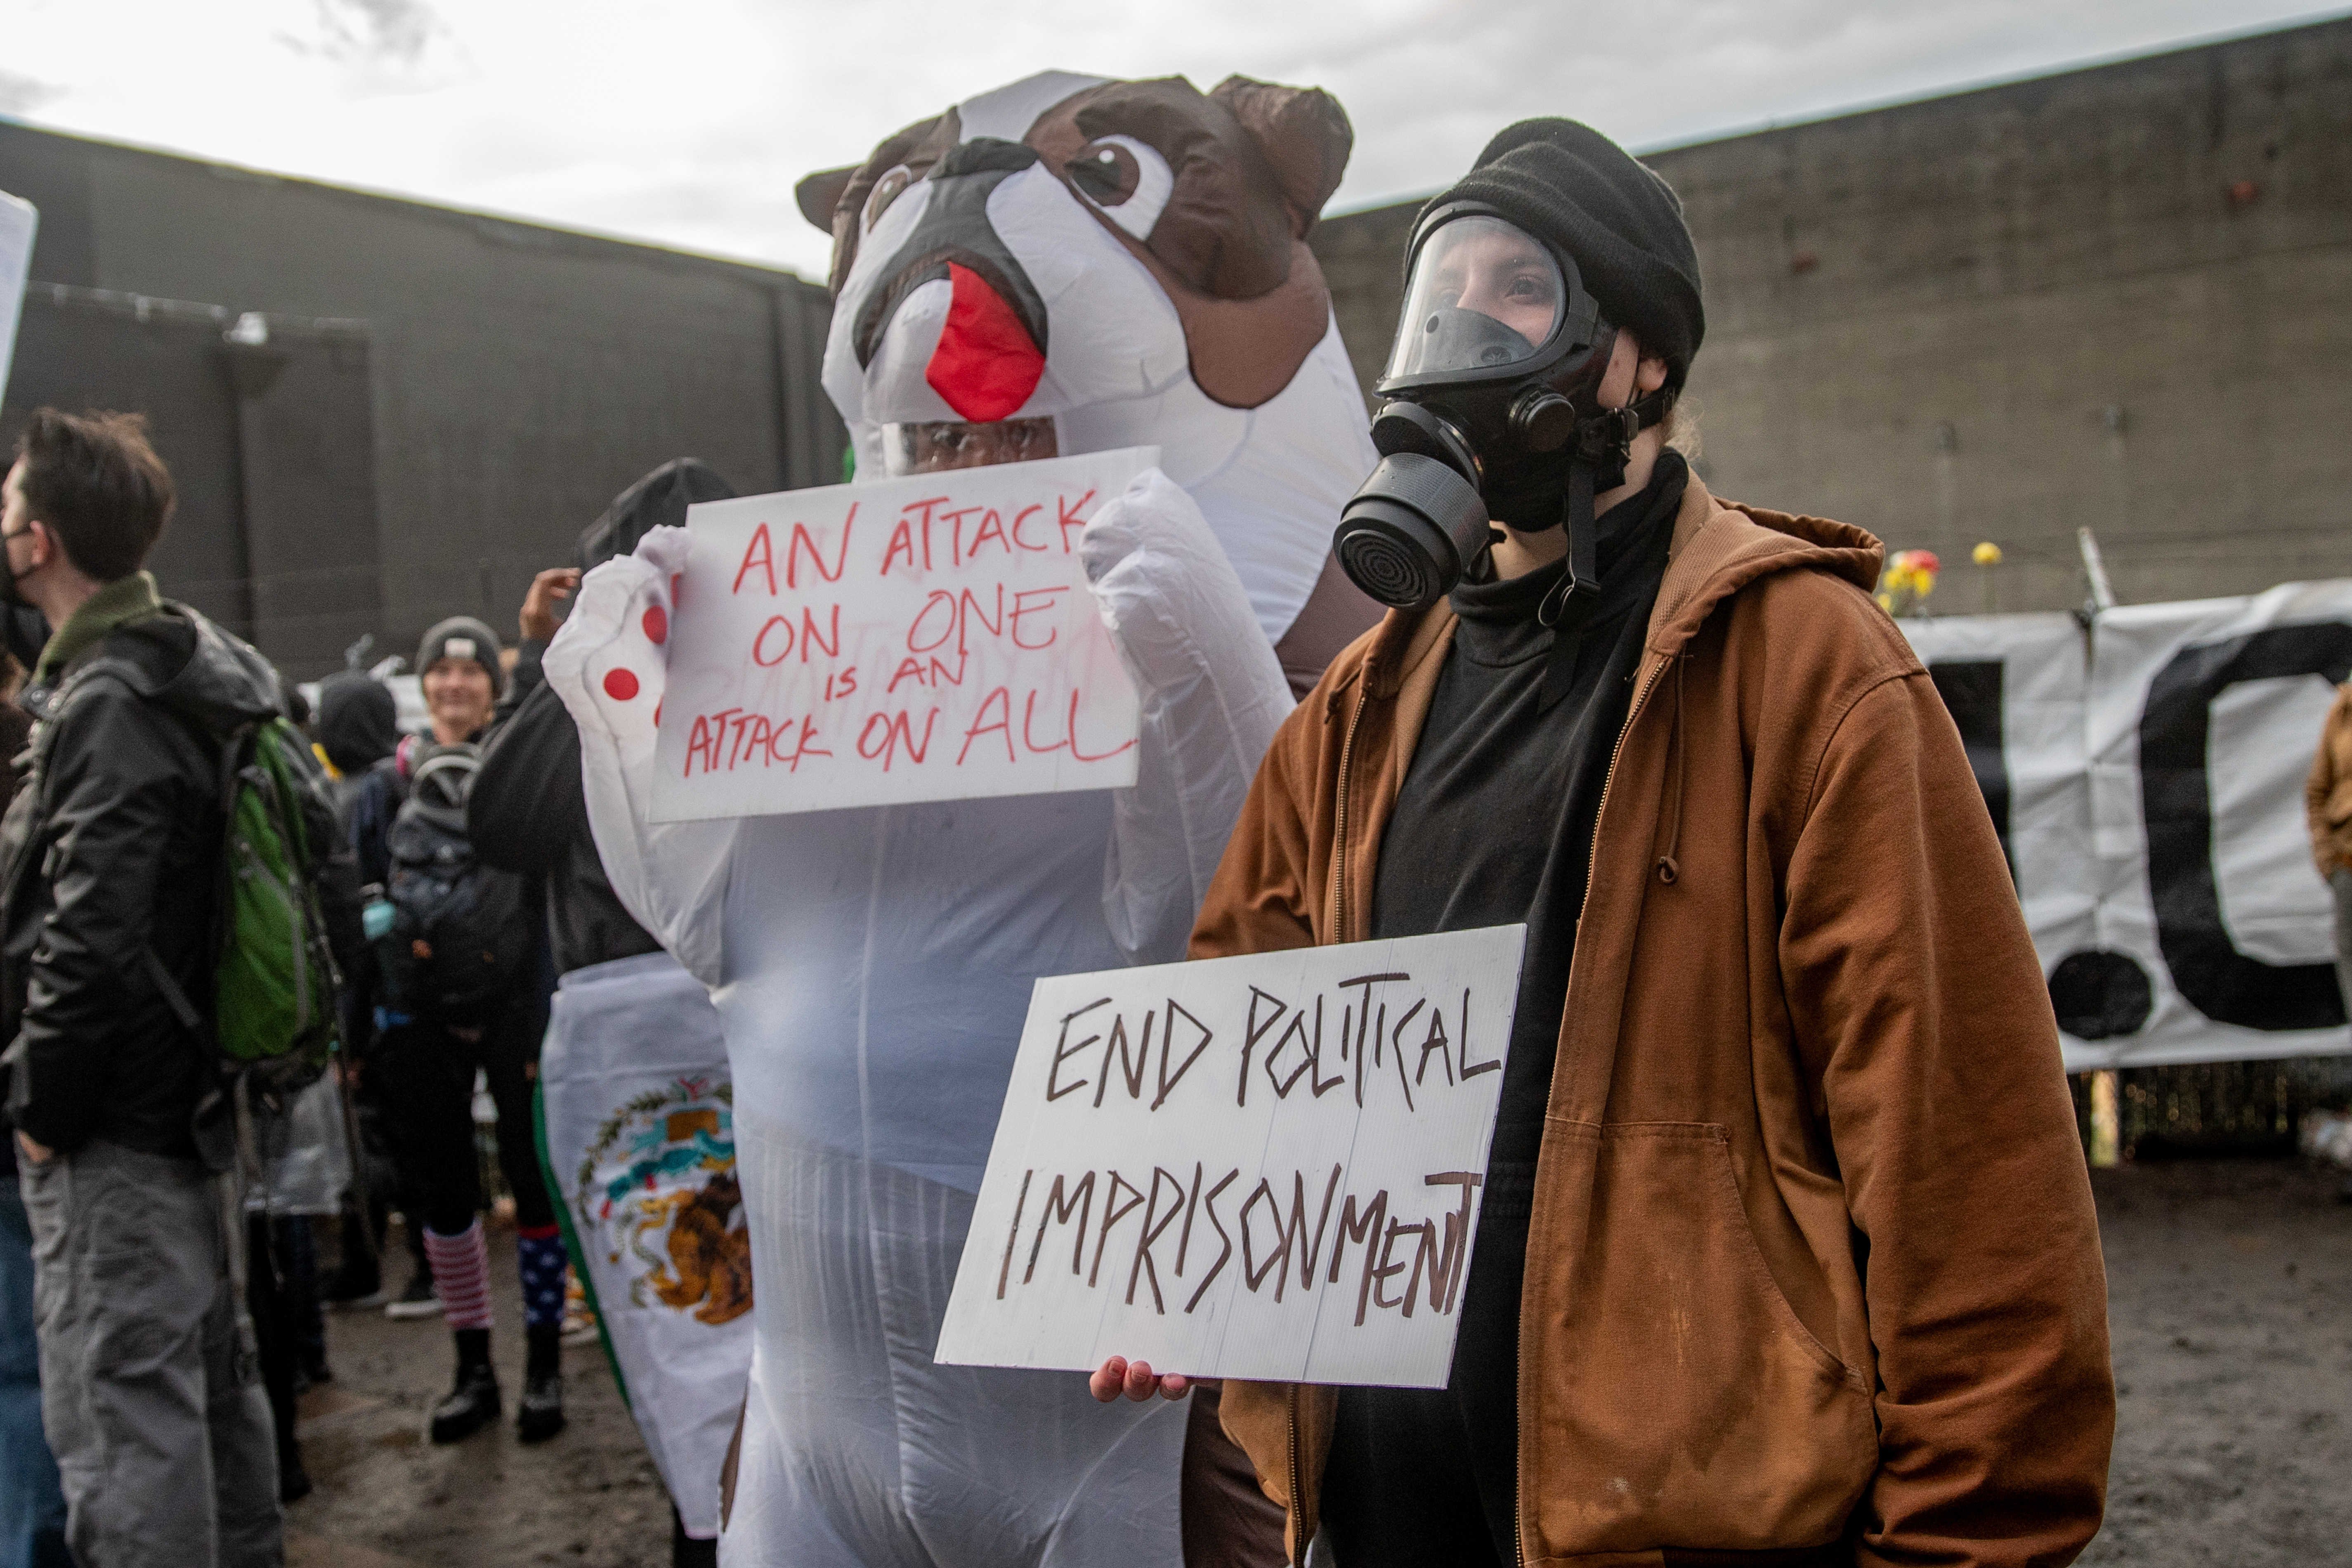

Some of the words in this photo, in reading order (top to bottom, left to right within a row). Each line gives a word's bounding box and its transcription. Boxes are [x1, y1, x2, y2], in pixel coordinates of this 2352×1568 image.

[732, 502, 860, 595] AN
[881, 489, 1096, 575] ATTACK
[753, 603, 841, 667] ON
[906, 582, 1070, 651] ONE
[824, 666, 857, 702] IS
[887, 651, 968, 694] AN
[684, 707, 833, 777] ATTACK
[857, 706, 940, 772] ON
[957, 686, 1140, 765] ALL
[1046, 997, 1213, 1112] END
[1237, 972, 1502, 1112] POLITICAL
[997, 1162, 1483, 1327] IMPRISONMENT
